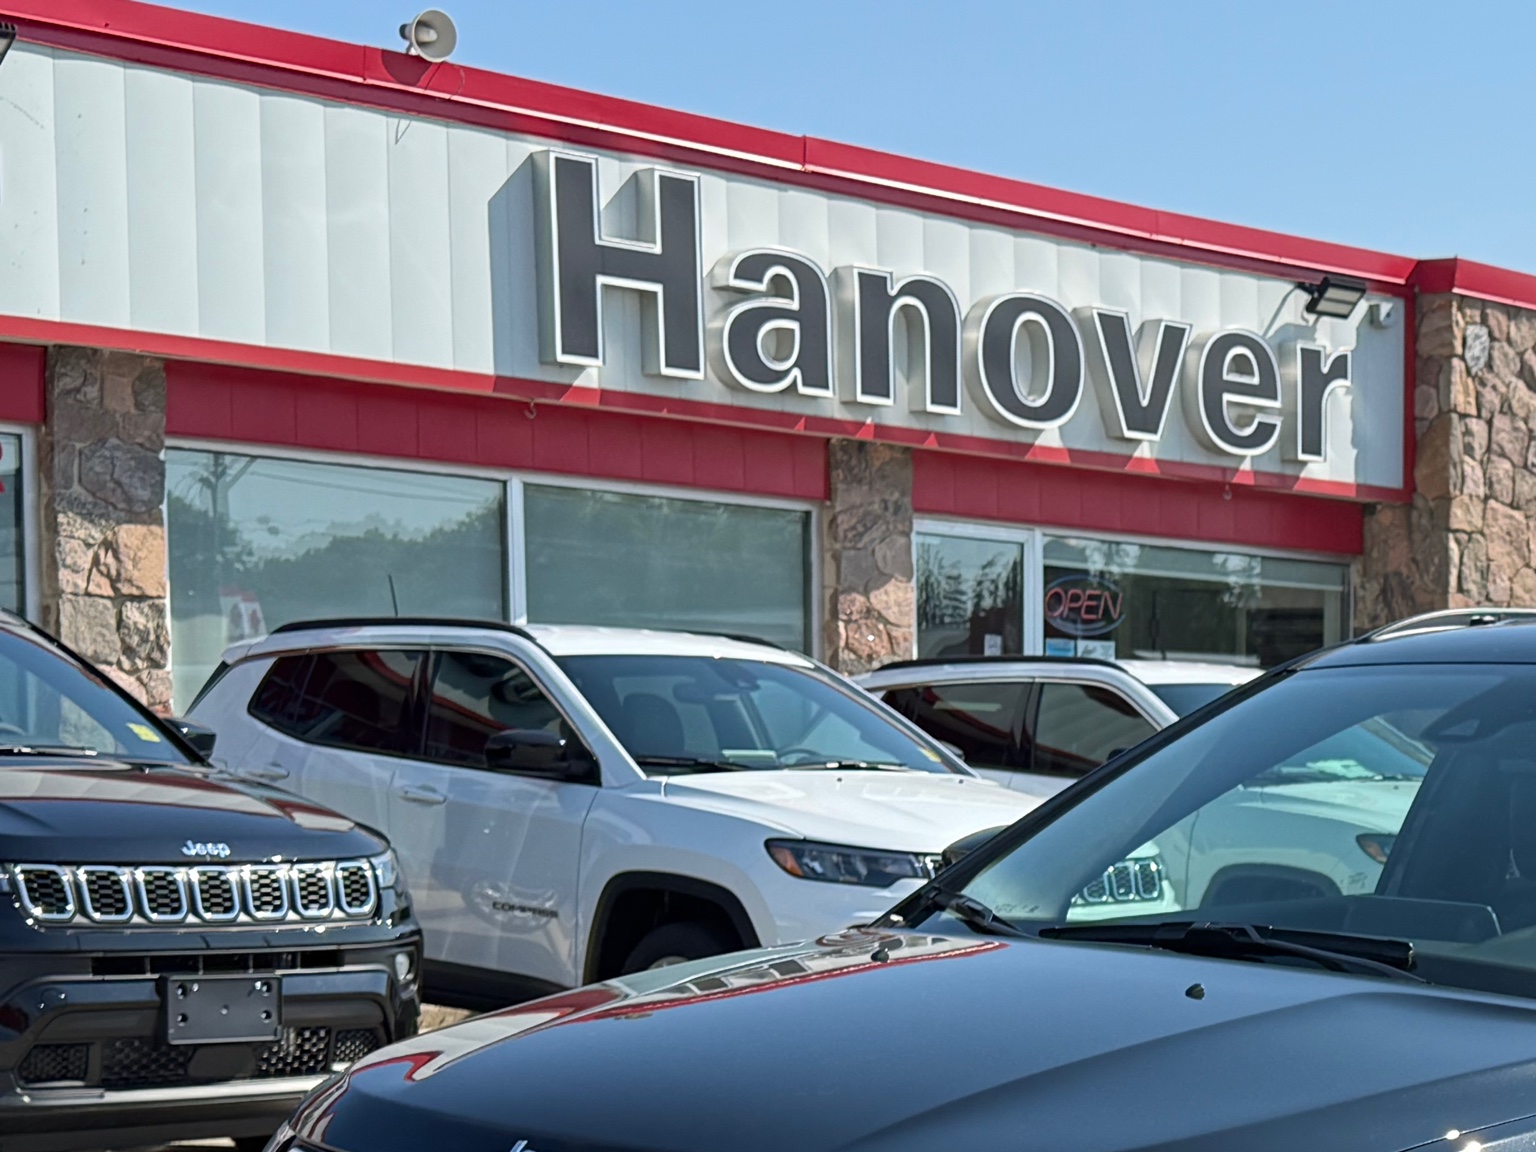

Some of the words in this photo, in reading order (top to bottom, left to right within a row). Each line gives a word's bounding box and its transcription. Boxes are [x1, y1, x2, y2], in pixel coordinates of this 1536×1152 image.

[543, 148, 1352, 463] Hanover
[1045, 587, 1123, 620] OPEN
[181, 840, 231, 859] Jeep
